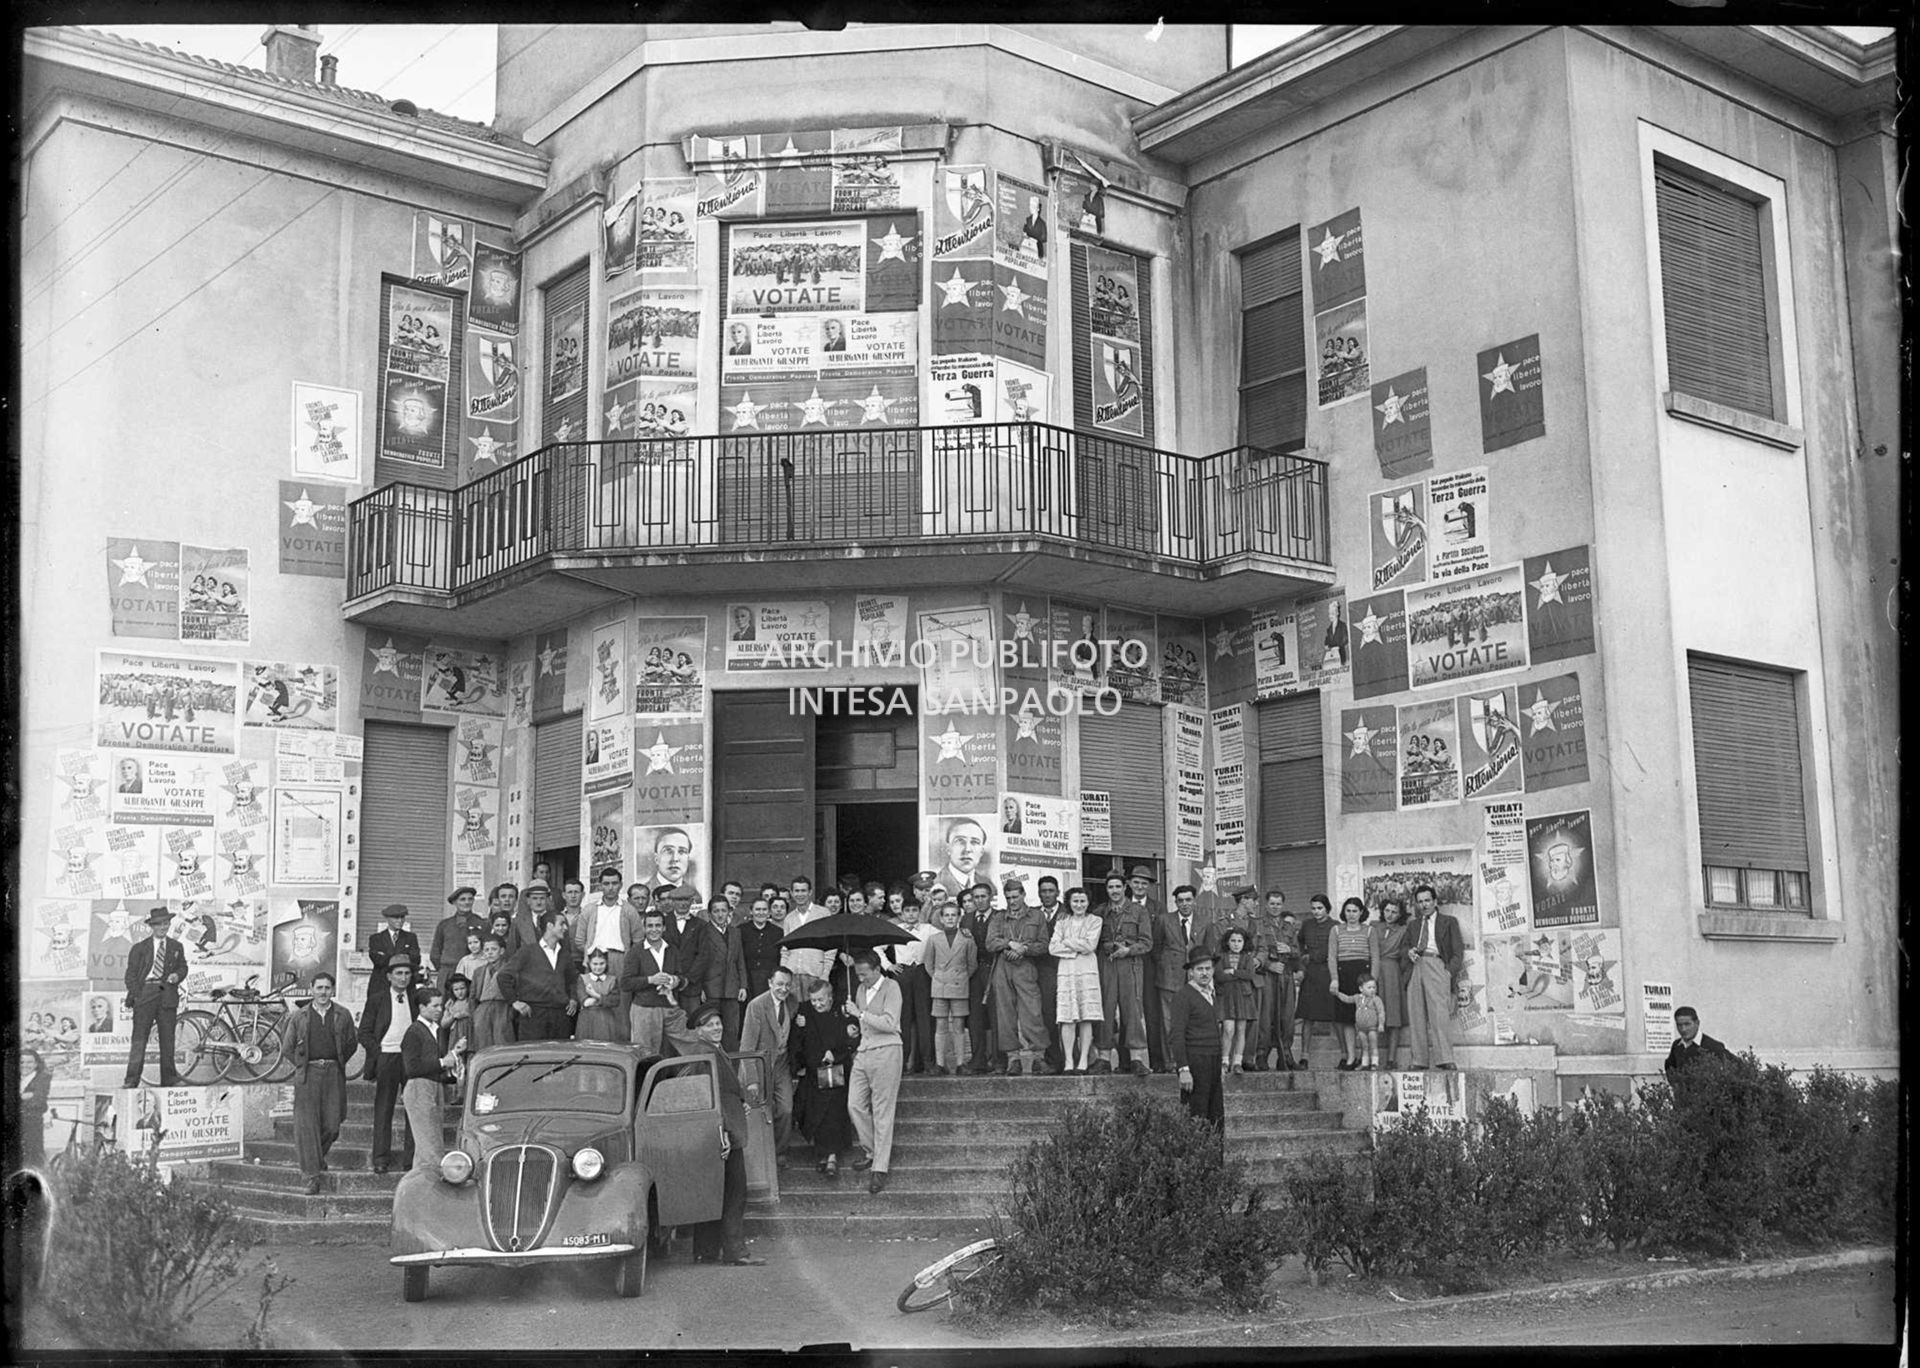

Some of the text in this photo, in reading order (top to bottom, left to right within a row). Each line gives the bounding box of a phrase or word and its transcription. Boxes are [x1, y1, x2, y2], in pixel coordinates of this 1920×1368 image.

[753, 286, 841, 305] VOTATE
[996, 320, 1045, 346] VOTATE
[771, 347, 810, 356] VOTATE
[866, 342, 905, 351] VOTATE
[617, 352, 681, 375] VOTATE
[1522, 355, 1540, 367] pace
[932, 369, 994, 381] Terza Guerra
[1519, 379, 1542, 391] lavoro
[1431, 485, 1486, 504] Terza Guerra
[283, 537, 344, 552] VOTATE
[1442, 569, 1451, 577] via
[1454, 565, 1469, 575] della
[1472, 562, 1489, 571] Pace
[1571, 567, 1590, 578] pace
[1424, 590, 1442, 600] Pace
[1477, 575, 1503, 587] Lavoro
[1568, 591, 1592, 604] lavoro
[110, 597, 177, 613] VOTATE
[761, 614, 788, 622] Libertà
[761, 622, 788, 630] Lavoro
[776, 632, 816, 641] VOTATE
[122, 658, 144, 667] Pace
[1429, 642, 1508, 674] VOTATE
[1563, 694, 1581, 705] pace
[1212, 707, 1240, 721] TURATI
[1381, 726, 1396, 735] pace
[1560, 720, 1584, 731] lavoro
[121, 721, 216, 744] VOTATE
[976, 731, 996, 740] pace
[684, 744, 703, 753] pace
[1525, 739, 1585, 764] VOTATE
[149, 760, 168, 769] Pace
[972, 755, 996, 763] lavoro
[1010, 753, 1061, 769] VOTATE
[679, 766, 704, 774] lavoro
[1214, 764, 1243, 776] TURATI
[149, 776, 176, 784] Lavoro
[929, 773, 995, 788] VOTATE
[164, 788, 205, 797] VOTATE
[638, 784, 702, 799] VOTATE
[1025, 801, 1041, 809] Pace
[1485, 803, 1522, 814] TURATI
[1025, 817, 1047, 826] Lavoro
[1215, 820, 1243, 831] TURATI
[1038, 830, 1069, 839] VOTATE
[1378, 858, 1395, 867] Pace
[1431, 855, 1455, 864] Lavoro
[91, 955, 125, 967] VOT
[1644, 985, 1671, 995] TURATI
[1403, 1074, 1420, 1083] Pace
[168, 1089, 189, 1099] Pace
[168, 1097, 197, 1107] Libertà
[168, 1107, 198, 1116] Lavoro
[1426, 1105, 1455, 1116] OTATE
[185, 1116, 230, 1127] VOTATE
